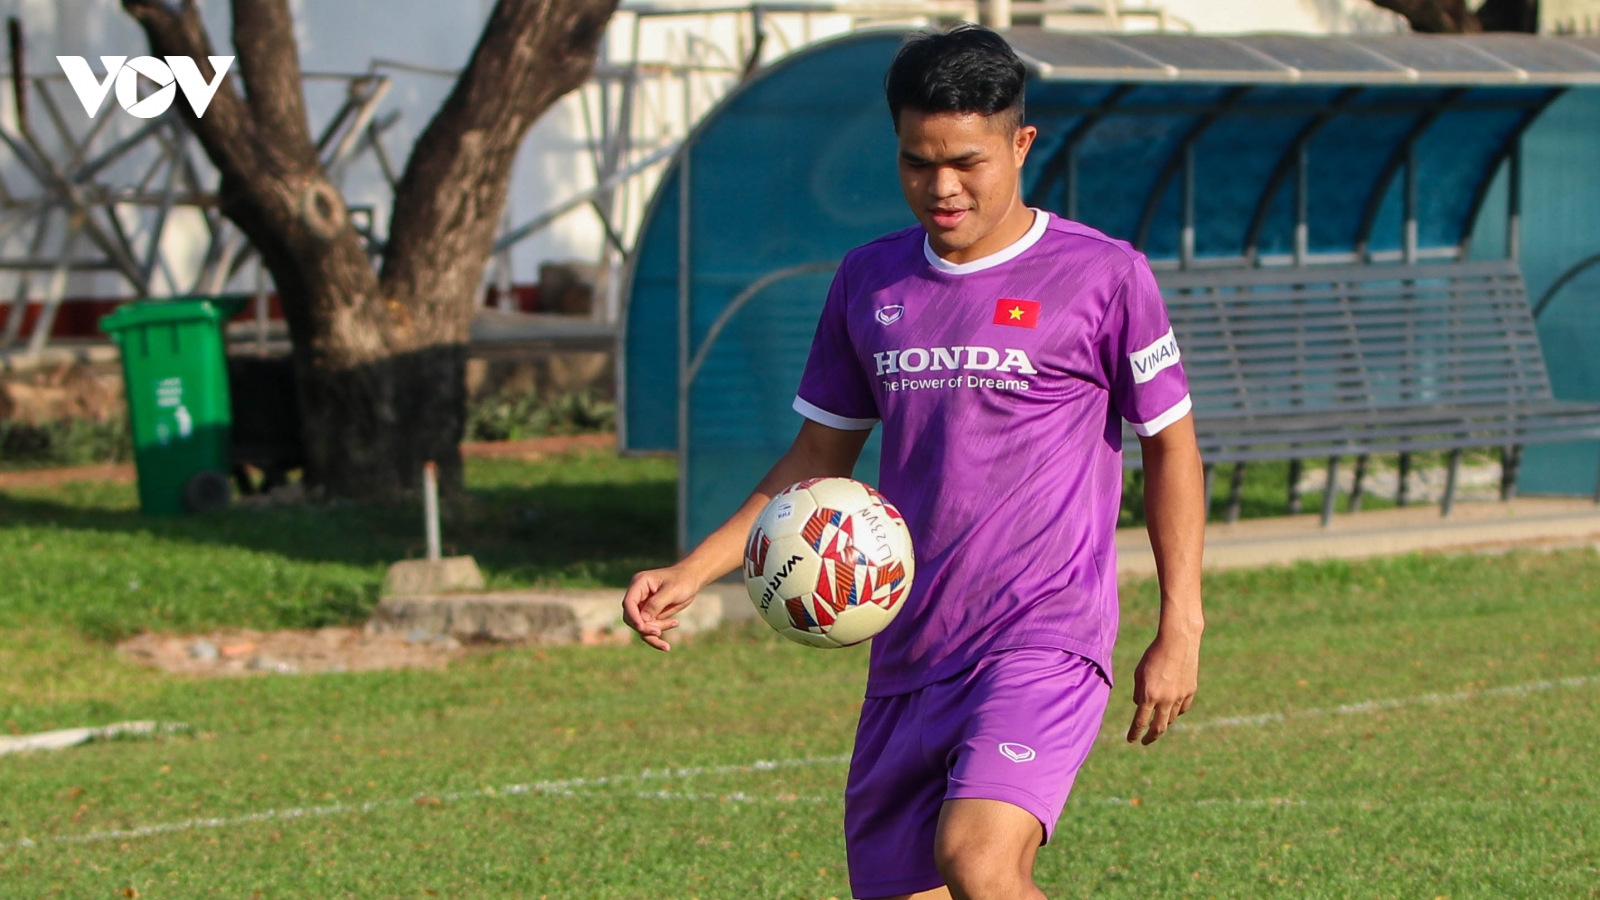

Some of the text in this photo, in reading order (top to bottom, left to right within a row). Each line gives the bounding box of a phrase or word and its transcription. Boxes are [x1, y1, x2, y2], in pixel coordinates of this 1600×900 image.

[873, 346, 1038, 376] HONDA
[902, 378, 945, 391] Power
[948, 376, 963, 389] of
[967, 375, 1029, 391] Dreams
[760, 554, 804, 614] WARRIX
